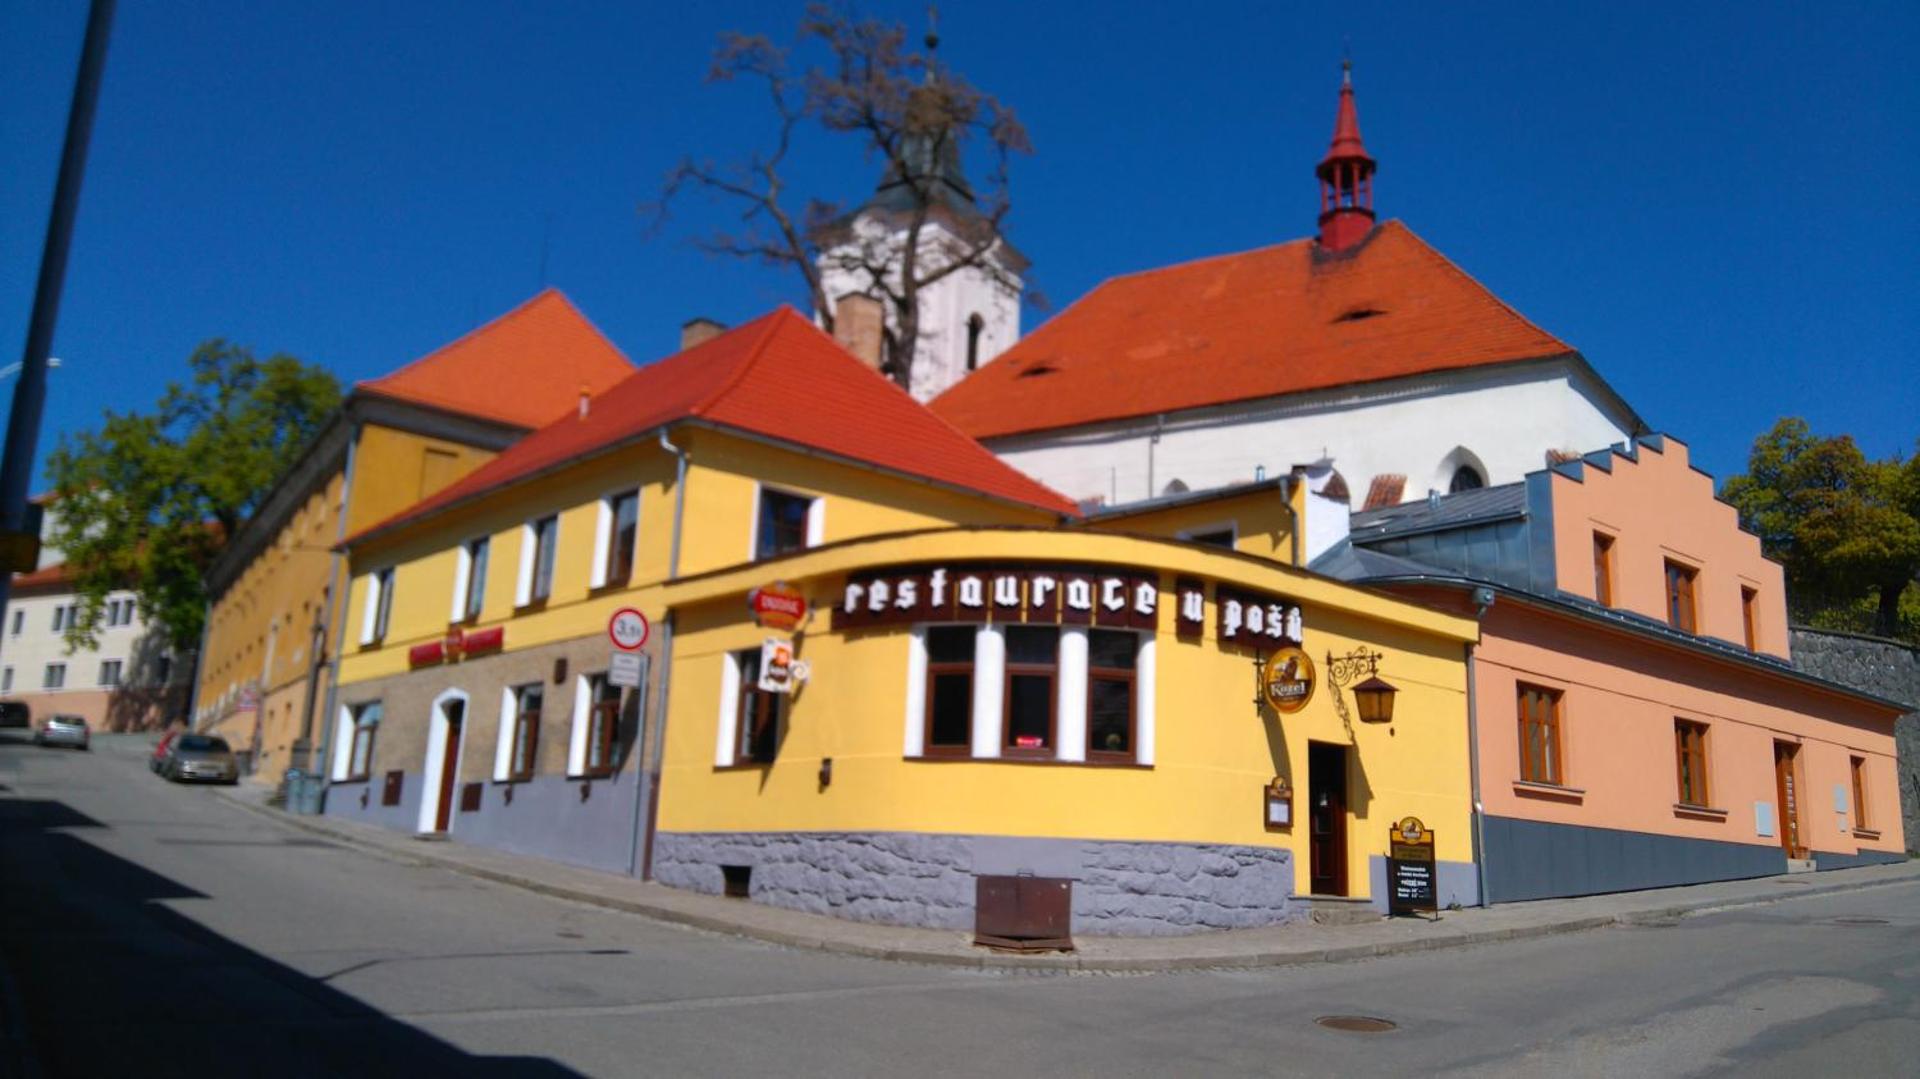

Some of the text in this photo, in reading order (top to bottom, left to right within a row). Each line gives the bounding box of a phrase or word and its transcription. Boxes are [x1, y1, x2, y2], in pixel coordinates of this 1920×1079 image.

[844, 568, 1157, 615] restaurace
[1183, 591, 1203, 622] u
[1270, 681, 1306, 697] Kozel
